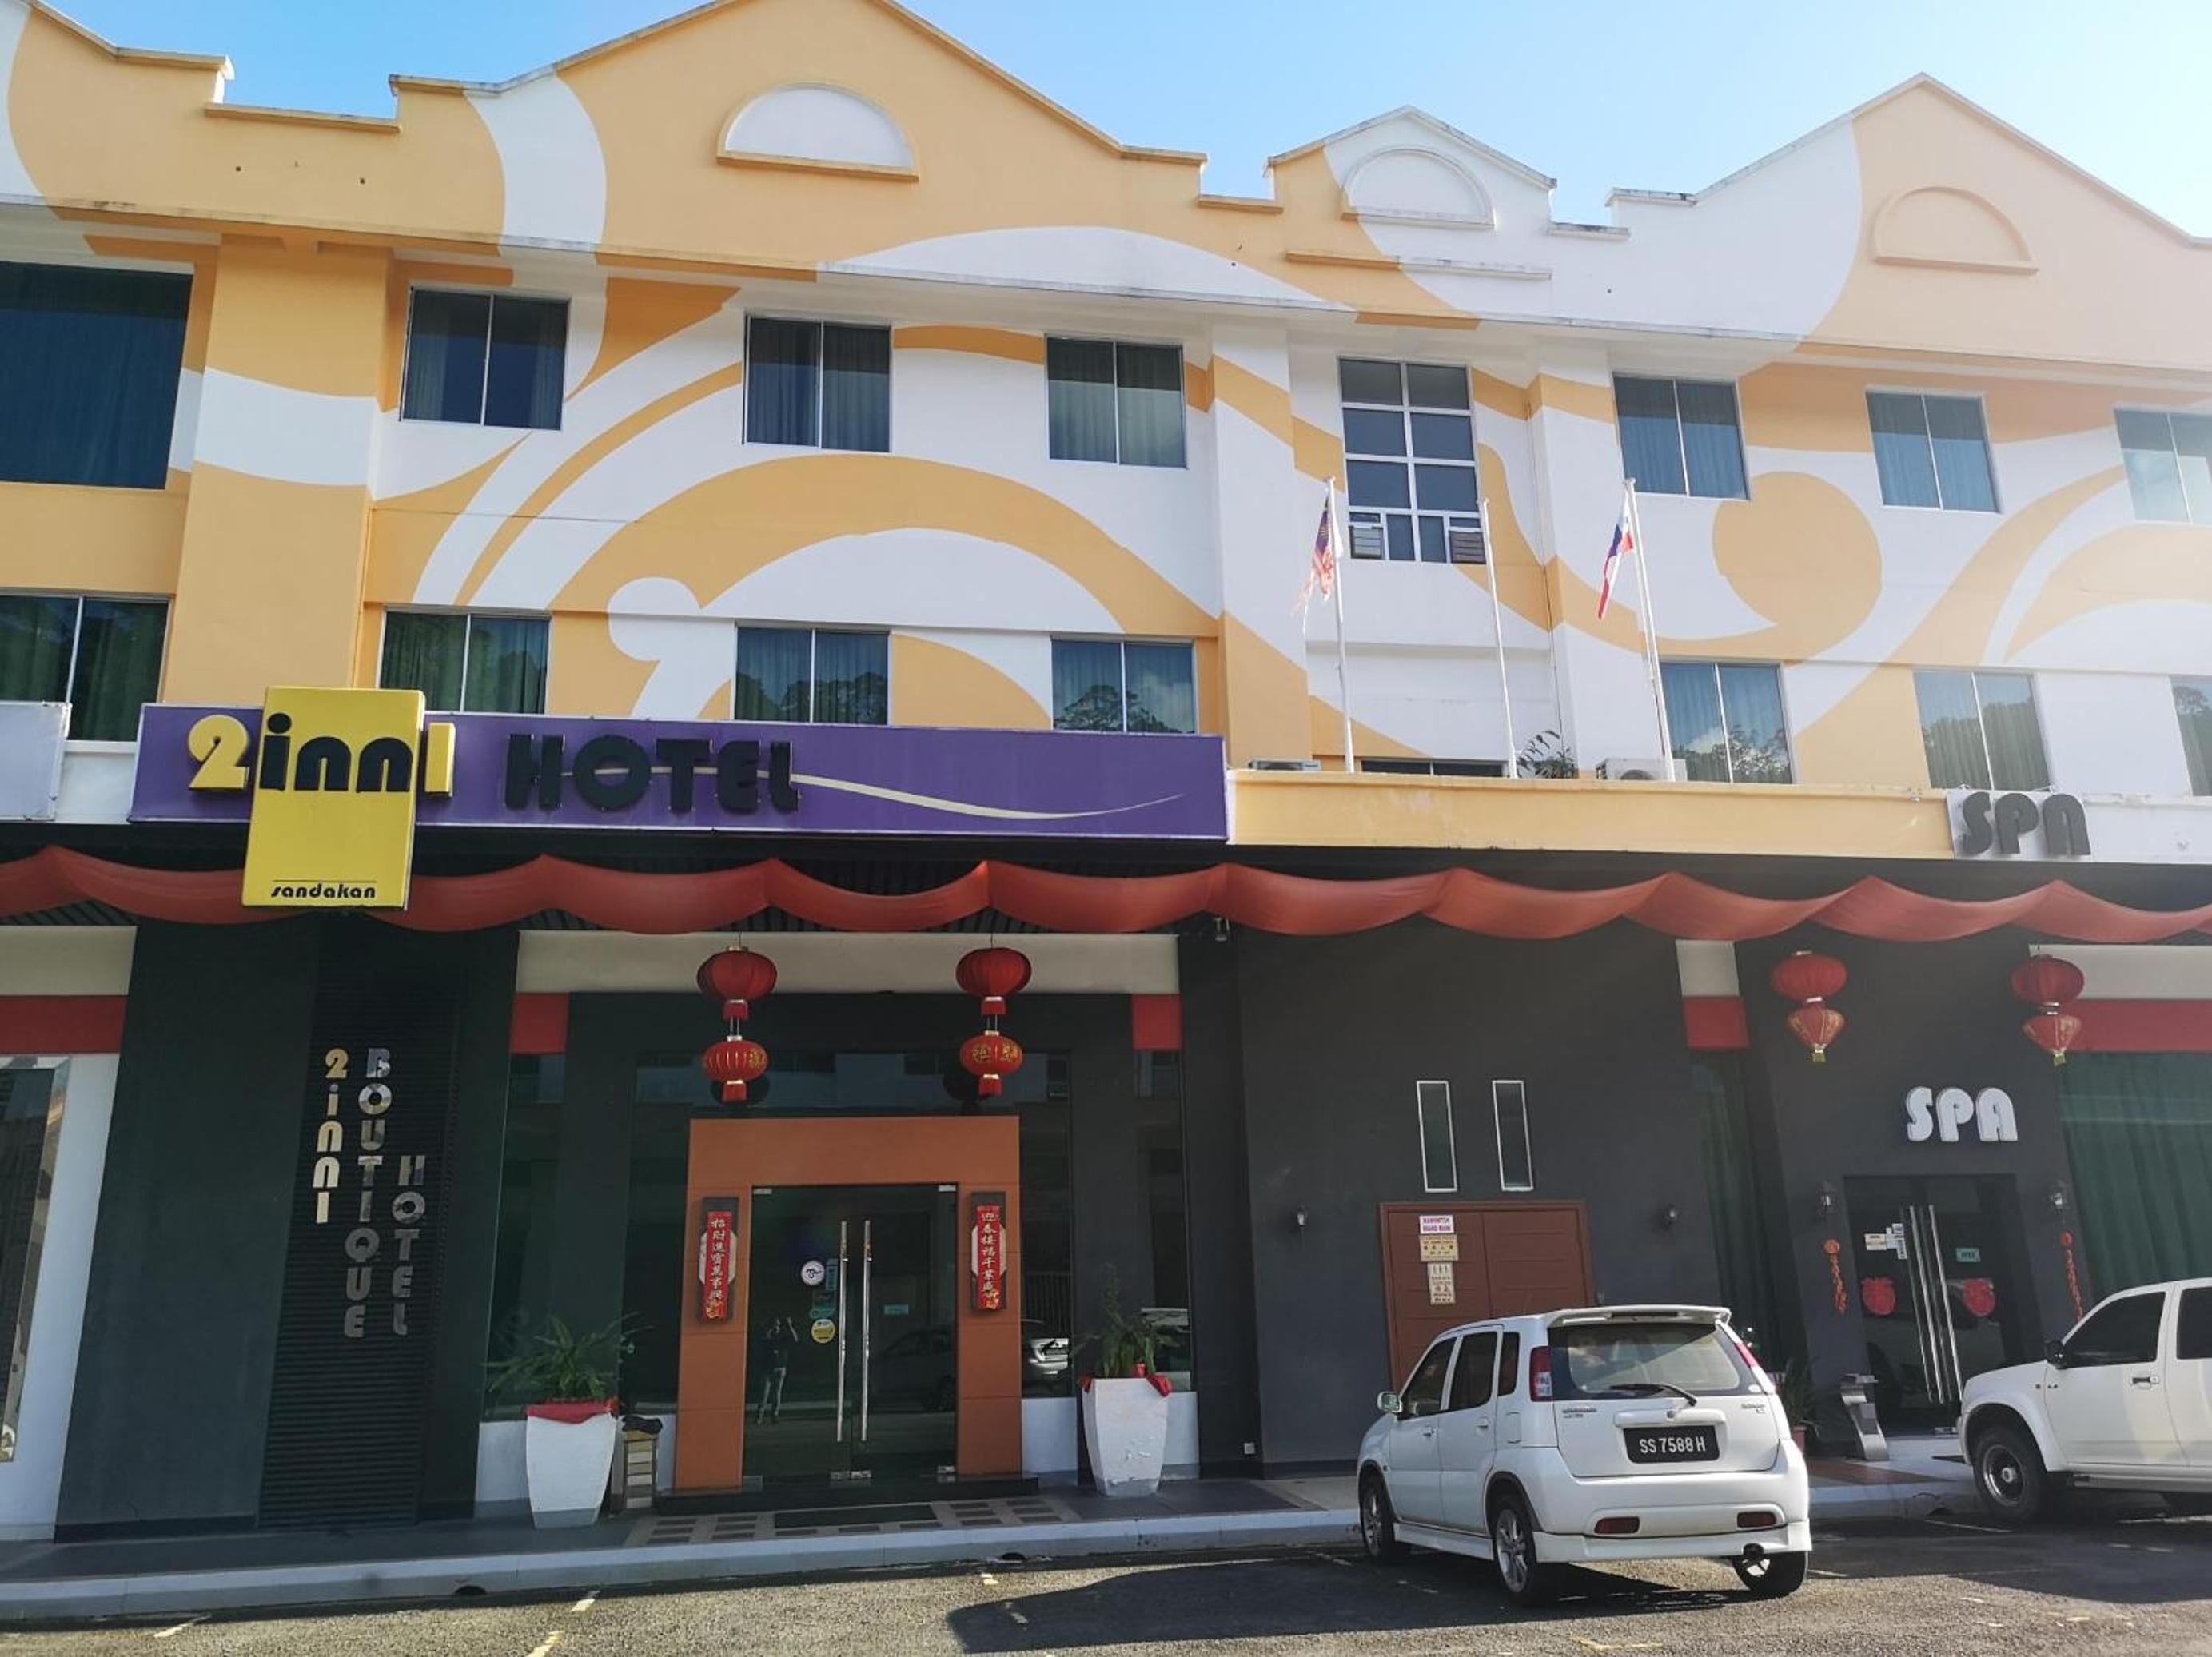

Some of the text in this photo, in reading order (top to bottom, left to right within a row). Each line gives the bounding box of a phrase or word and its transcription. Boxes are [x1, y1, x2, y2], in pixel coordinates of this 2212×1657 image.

[504, 733, 799, 815] HOTEL
[1963, 791, 2091, 854] SPA
[271, 883, 376, 898] sandakan
[1905, 1086, 2019, 1142] SPA
[344, 1048, 393, 1338] BOUTIQUE
[392, 1155, 426, 1336] HOTEL
[1639, 1438, 1657, 1454] SS
[1695, 1436, 1707, 1452] H
